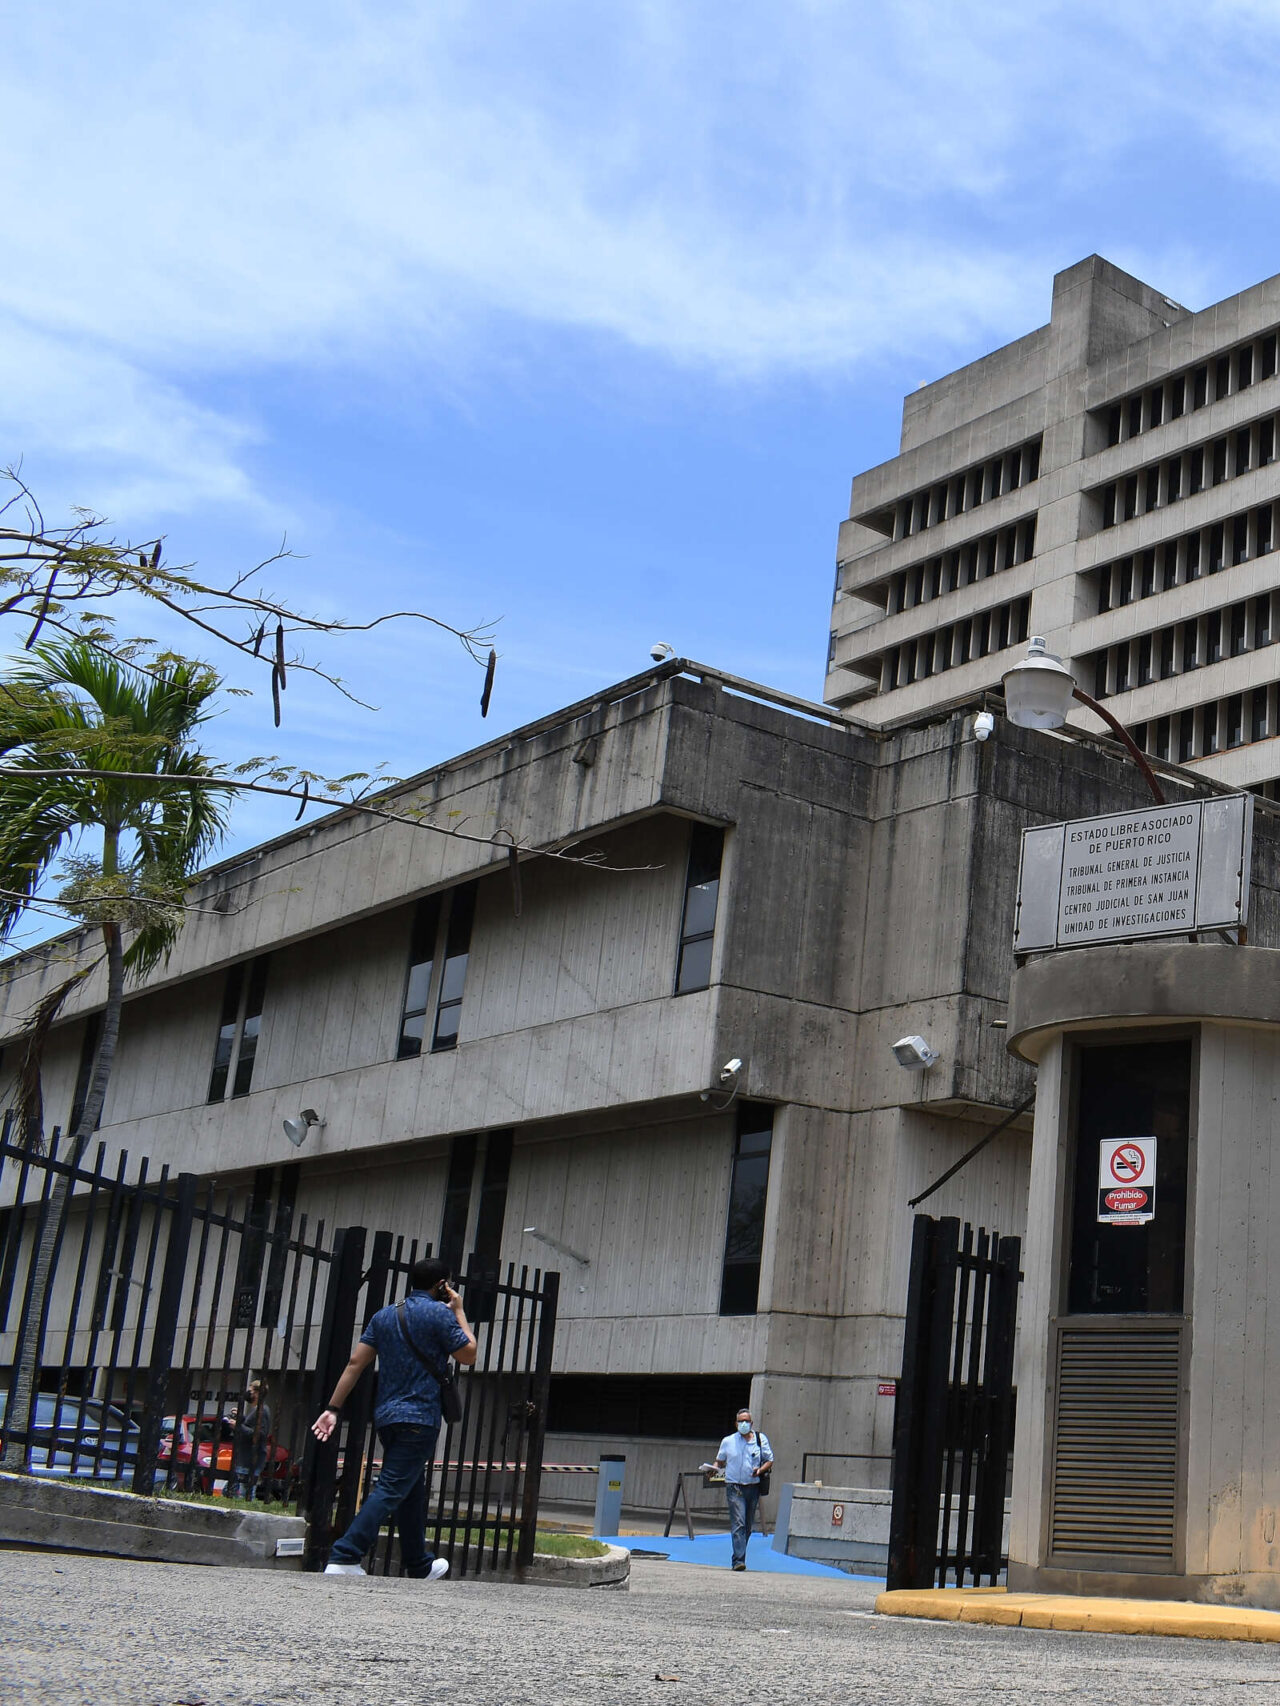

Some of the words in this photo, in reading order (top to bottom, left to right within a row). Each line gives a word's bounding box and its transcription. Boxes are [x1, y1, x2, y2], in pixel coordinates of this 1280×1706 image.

[1071, 828, 1108, 843] ESTADO
[1110, 823, 1140, 836] LIBRE
[1141, 814, 1193, 831] ASOCIADO
[1089, 842, 1102, 854] DE
[1105, 836, 1145, 852] PUERTO
[1147, 832, 1171, 845] RICO
[1069, 864, 1103, 878] TRIBUNAL
[1107, 858, 1139, 872] GENERAL
[1143, 856, 1153, 867] DE
[1156, 851, 1191, 865] JUSTICIA
[1067, 882, 1100, 896] TRIBUNAL
[1104, 880, 1112, 891] DE
[1115, 876, 1147, 889] PRIMERA
[1151, 870, 1189, 885] INSTANCIA
[1064, 902, 1092, 915] CENTRO
[1095, 897, 1130, 911] JUDICIAL
[1134, 895, 1144, 906] DE
[1147, 892, 1164, 904] SAN
[1168, 889, 1189, 902] JUAN
[1064, 920, 1094, 934] UNIDAD
[1098, 918, 1108, 929] DE
[1112, 909, 1186, 927] INVESTIGACIONES
[1109, 1190, 1143, 1200] Prohibido
[1114, 1201, 1137, 1210] Fumar
